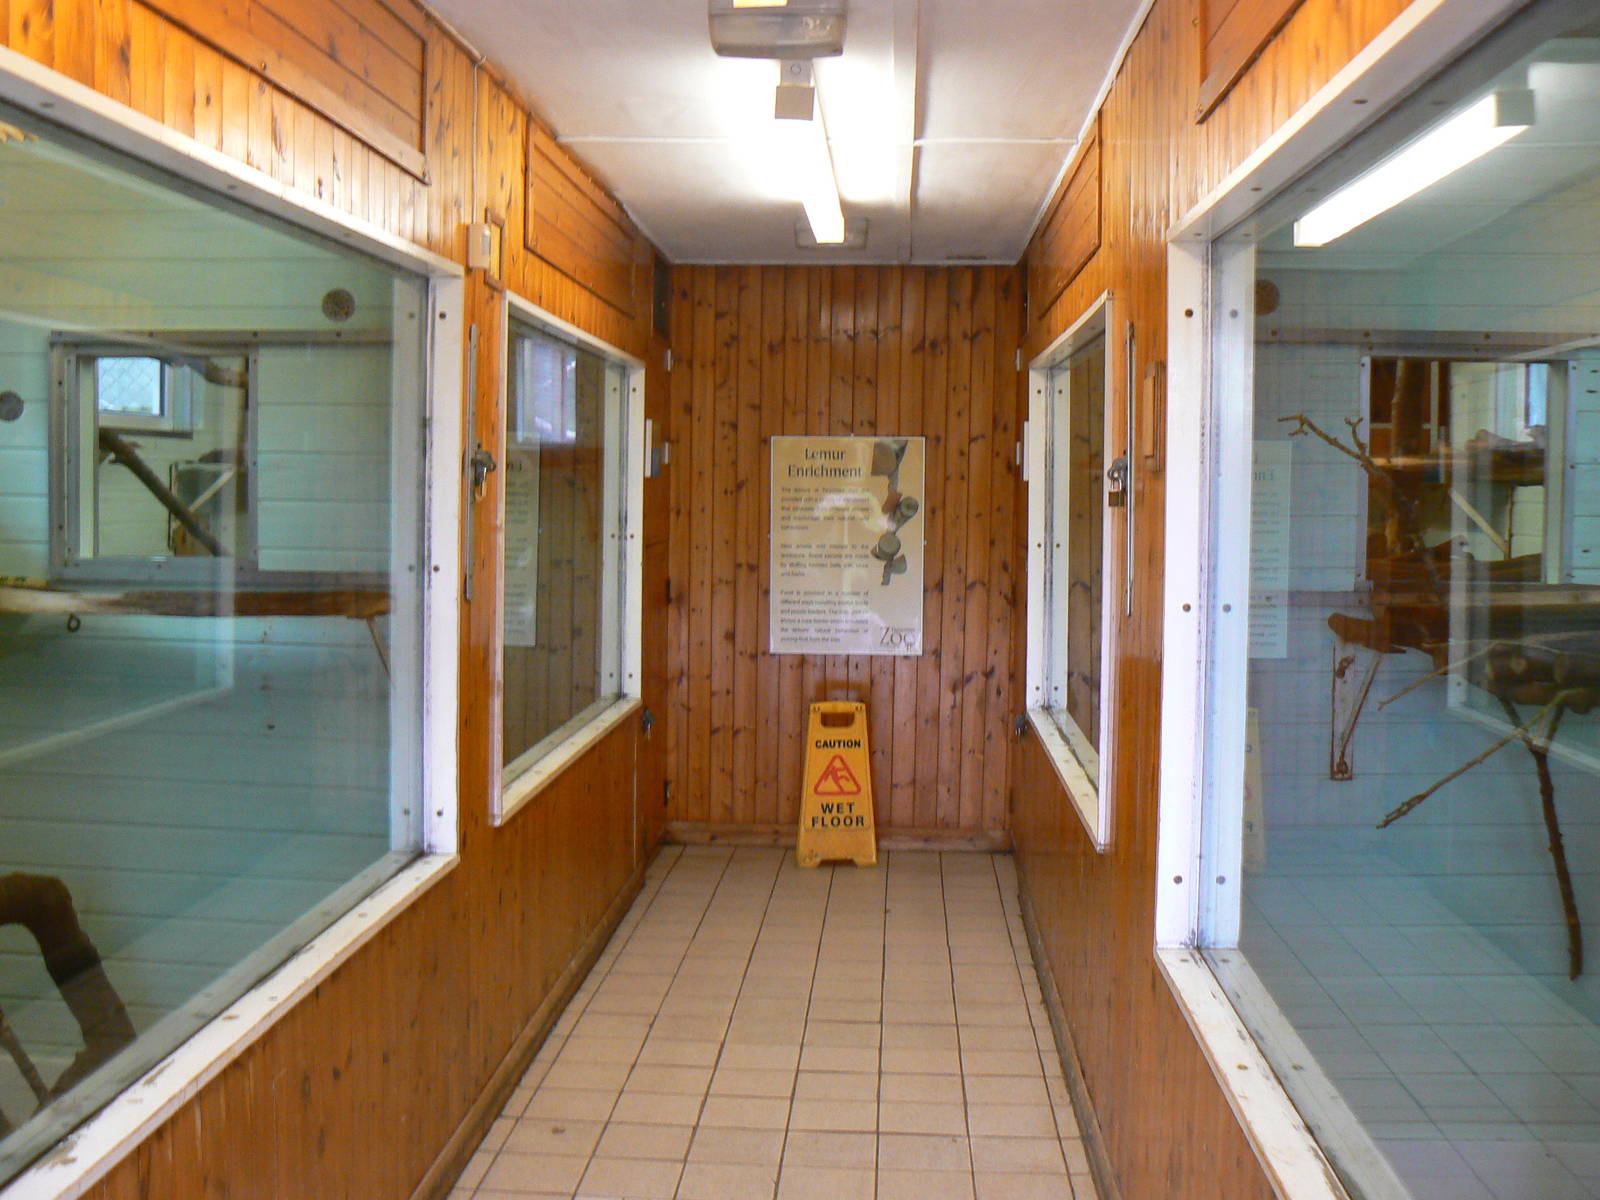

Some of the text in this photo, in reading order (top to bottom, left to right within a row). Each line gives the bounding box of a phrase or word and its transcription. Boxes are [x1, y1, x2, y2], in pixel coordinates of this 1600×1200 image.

[804, 448, 846, 460] Lemur
[788, 464, 863, 478] Enrichment
[815, 739, 861, 749] CAUTION
[821, 802, 855, 815] WET
[811, 815, 864, 828] FLOOR
